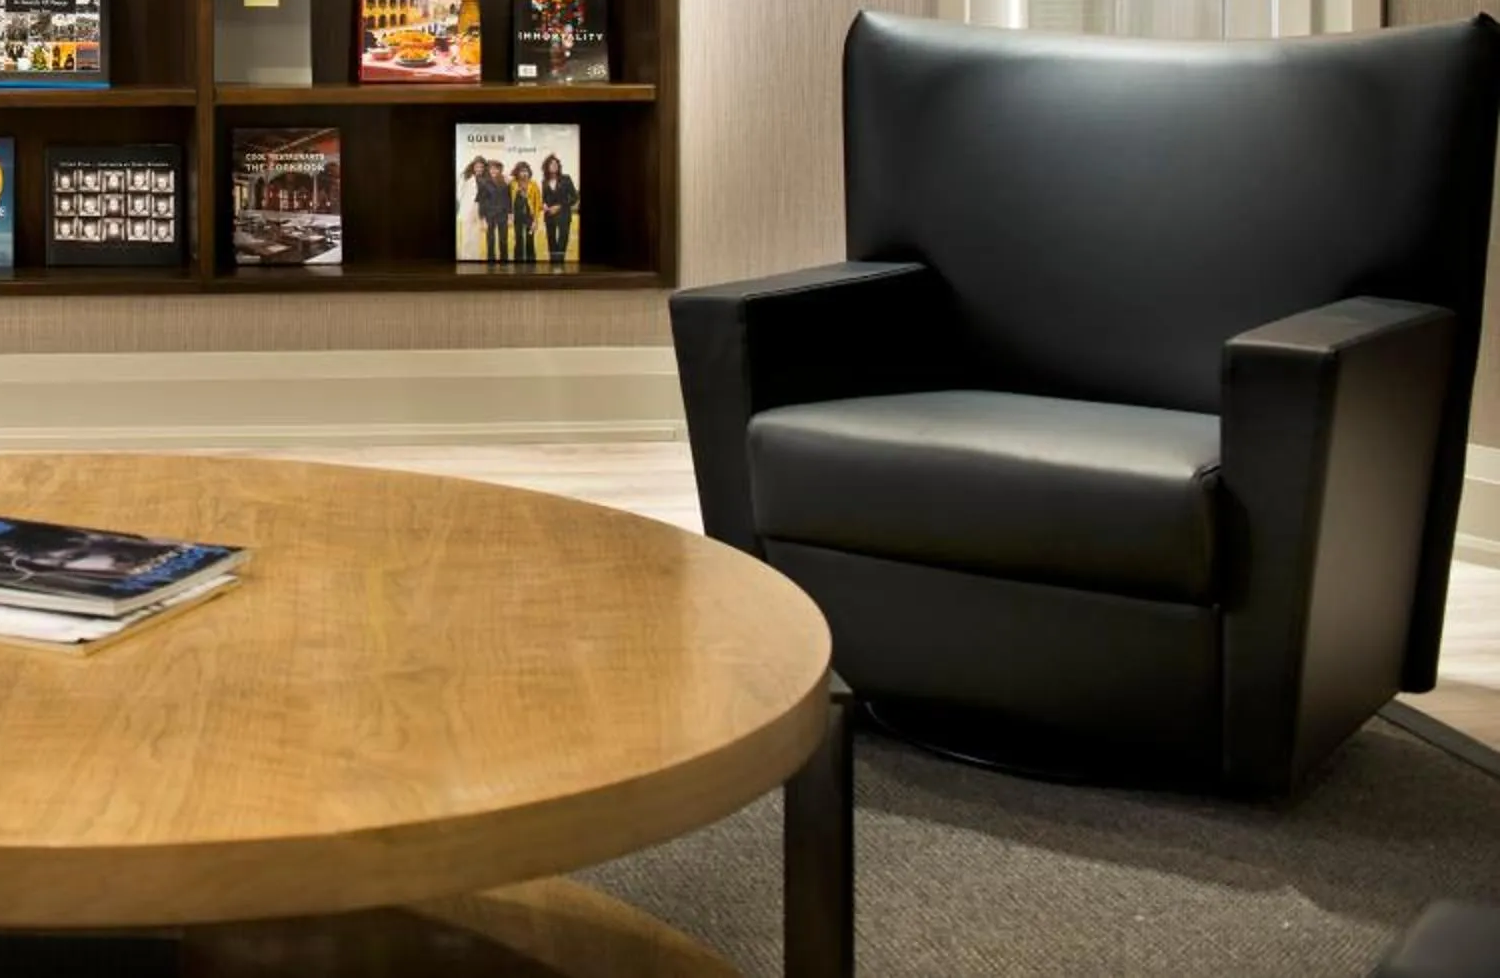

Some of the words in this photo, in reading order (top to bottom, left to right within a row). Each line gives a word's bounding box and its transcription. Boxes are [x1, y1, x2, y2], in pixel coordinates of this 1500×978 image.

[517, 31, 604, 41] IMMORTALITY
[467, 134, 505, 143] QUEEN
[245, 163, 264, 171] THE
